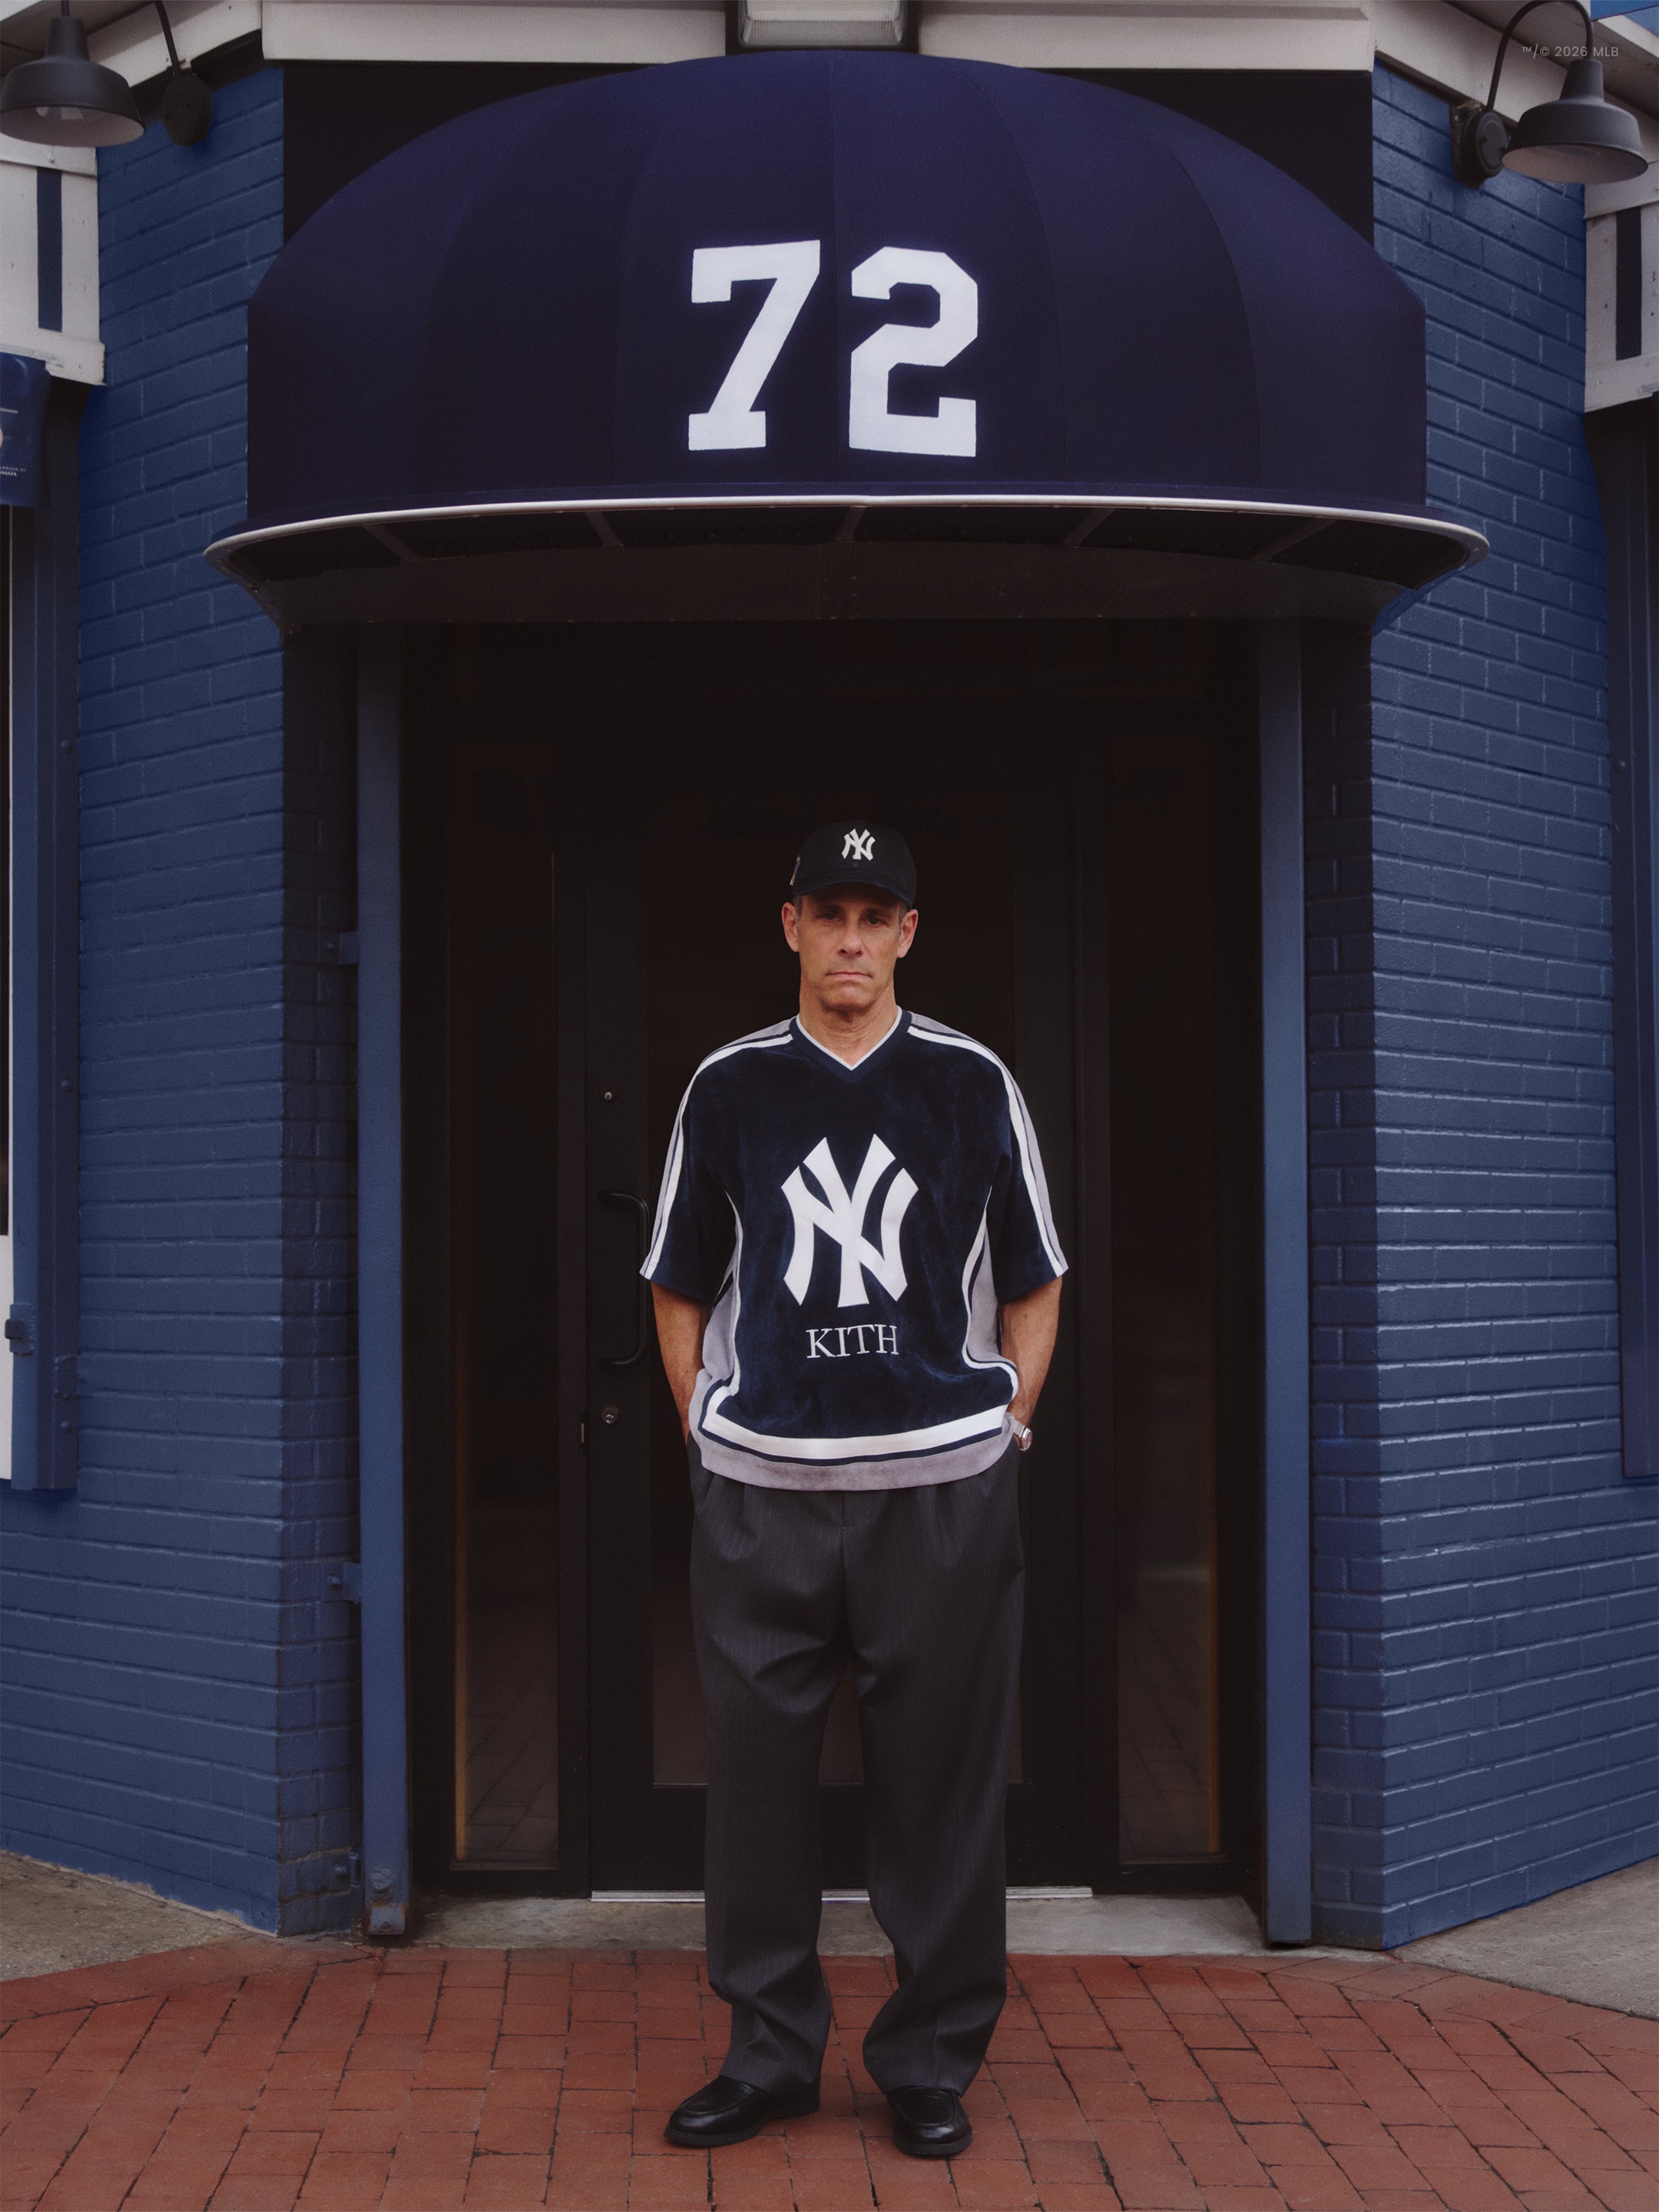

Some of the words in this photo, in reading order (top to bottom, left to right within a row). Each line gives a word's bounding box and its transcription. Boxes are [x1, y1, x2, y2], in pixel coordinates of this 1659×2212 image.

[688, 240, 979, 457] 72
[841, 828, 876, 861] NY
[780, 1133, 919, 1308] NY
[806, 1324, 899, 1359] KITH
